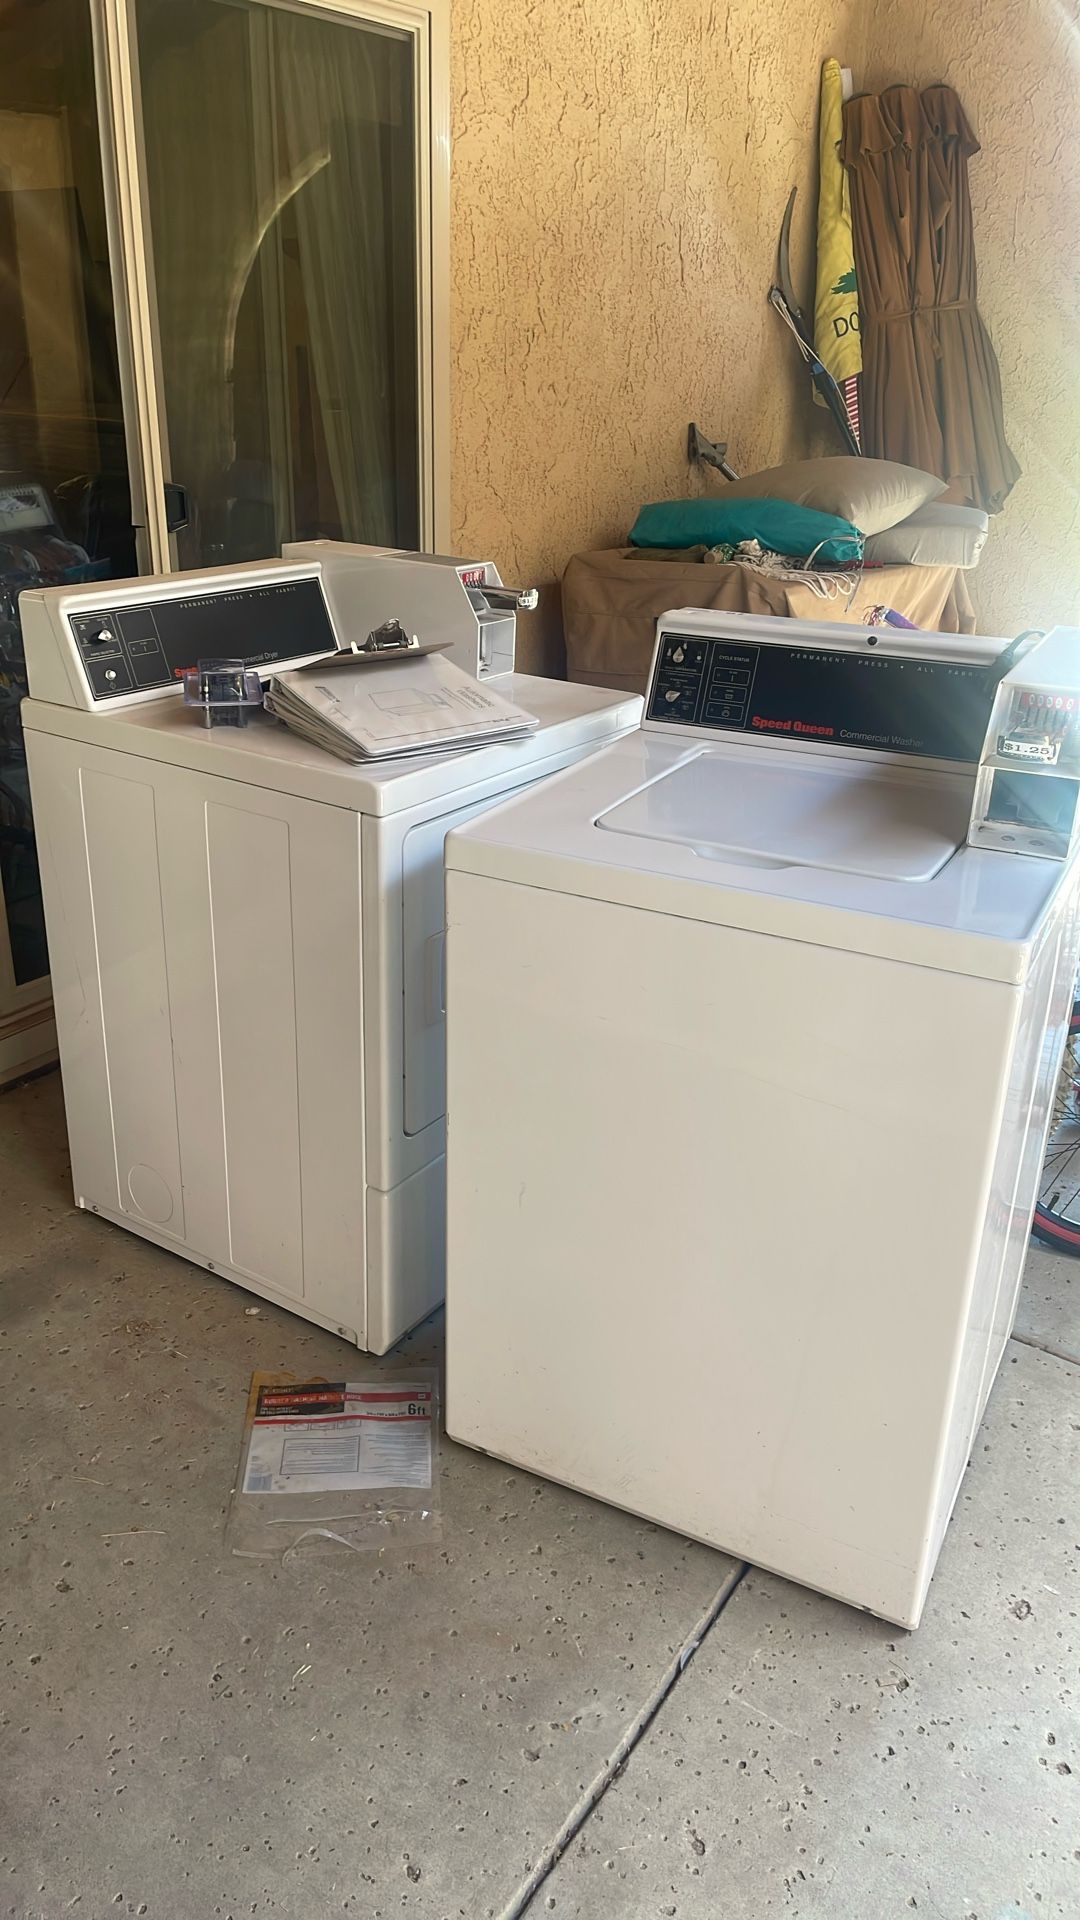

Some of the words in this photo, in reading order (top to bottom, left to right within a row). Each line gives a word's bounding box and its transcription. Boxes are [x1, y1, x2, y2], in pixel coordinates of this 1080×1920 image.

[790, 653, 847, 664] PERMANENT
[858, 659, 889, 669] PRESS
[917, 666, 935, 674] ALL
[752, 716, 792, 731] Speed
[793, 720, 834, 736] Queen
[840, 729, 890, 744] Commercial
[1004, 743, 1050, 755] $1.25
[407, 1403, 426, 1416] 6ft
